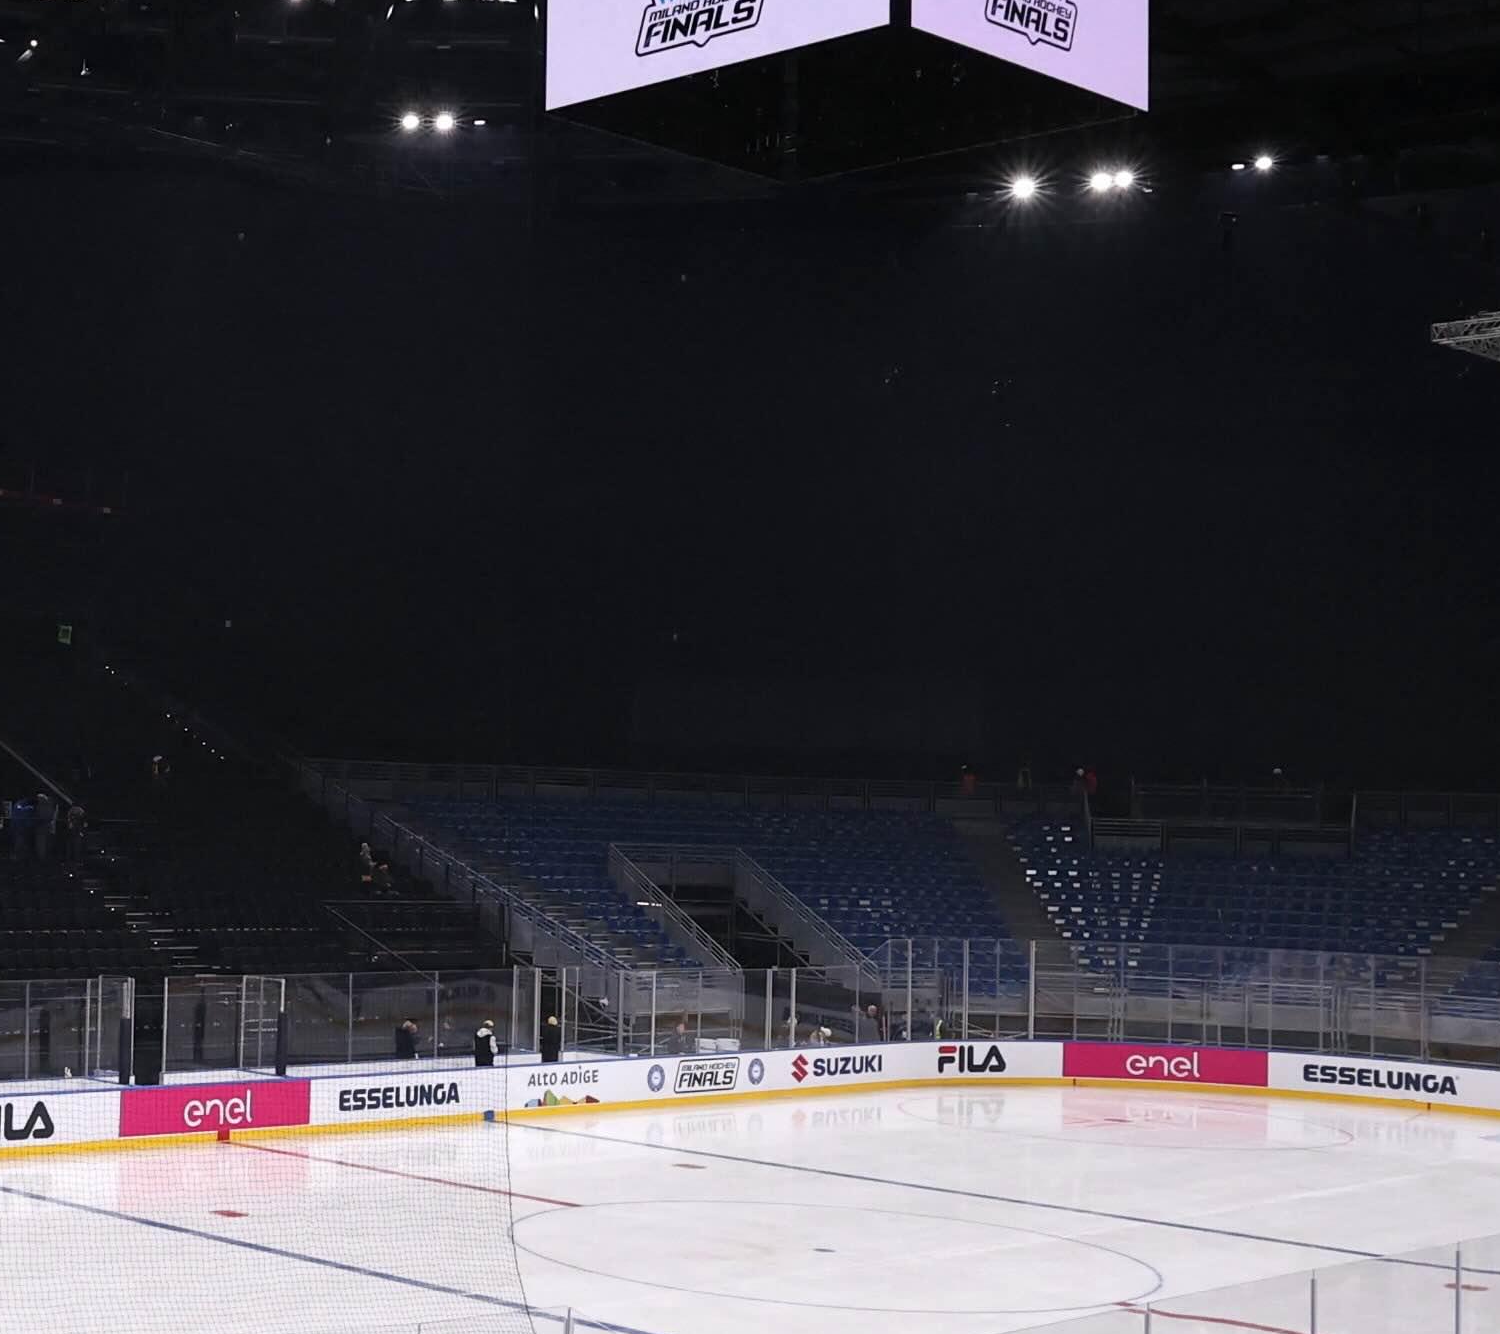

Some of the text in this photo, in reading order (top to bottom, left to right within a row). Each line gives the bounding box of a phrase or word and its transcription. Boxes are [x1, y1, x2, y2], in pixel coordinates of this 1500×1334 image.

[649, 0, 700, 22] MILANO
[813, 1054, 882, 1077] SUZUKI
[937, 1044, 1007, 1074] FILA
[1126, 1051, 1200, 1078] enel
[678, 1069, 734, 1088] FINALS
[1303, 1064, 1457, 1096] ESSELUNGA
[183, 1089, 253, 1127] enel
[339, 1082, 460, 1112] ESSELUNGA
